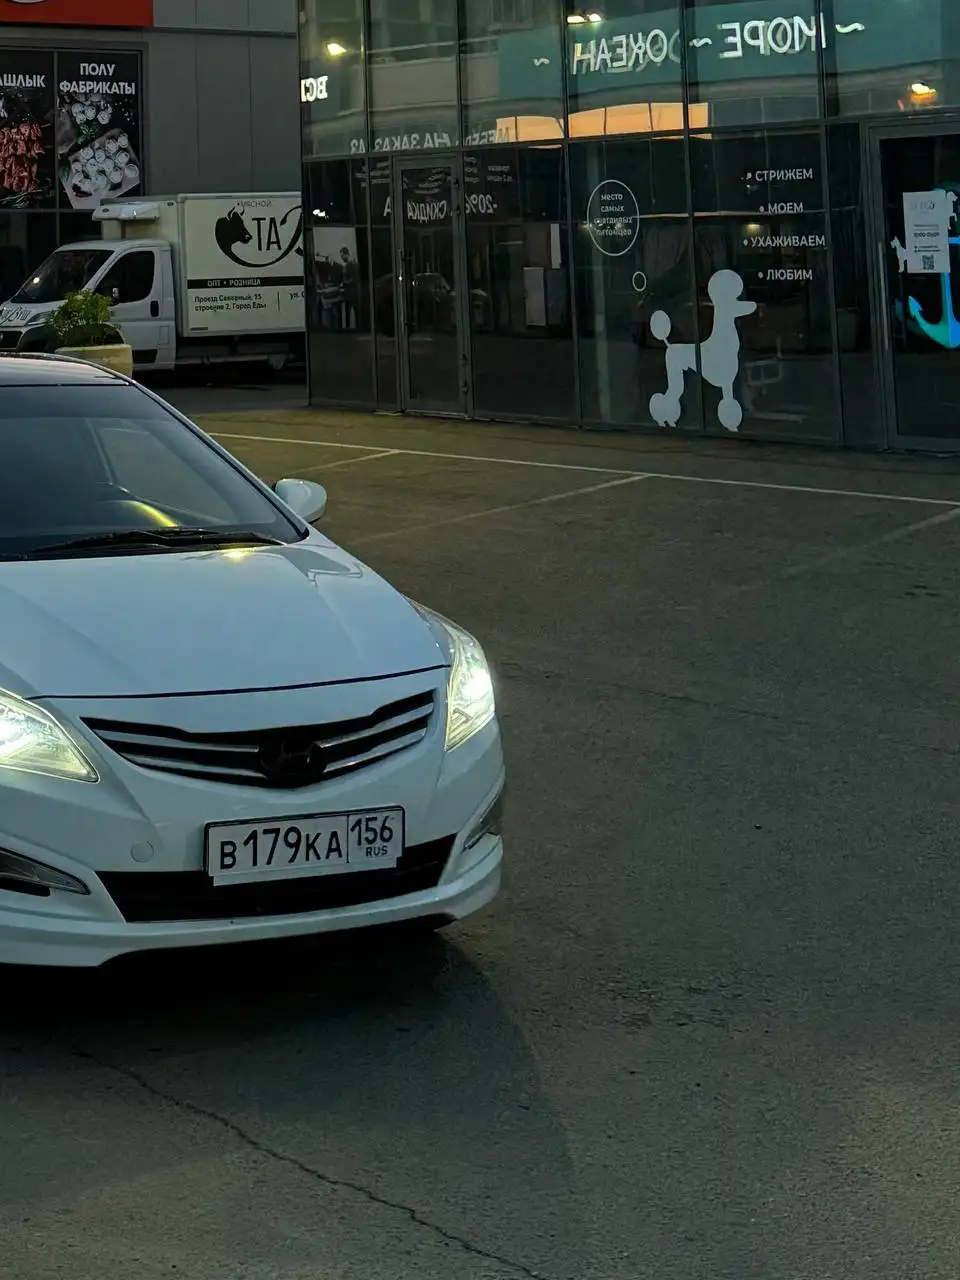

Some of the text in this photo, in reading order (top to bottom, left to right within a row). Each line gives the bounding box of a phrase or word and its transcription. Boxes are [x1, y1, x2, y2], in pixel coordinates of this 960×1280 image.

[79, 63, 115, 76] ПОЛУ
[59, 80, 136, 95] ФАБРИКАТЫ
[755, 168, 813, 182] СТРИЖЕМ
[768, 202, 804, 214] МОЕМ
[750, 235, 825, 248] УХАЖИВАЕМ
[767, 269, 813, 281] ЛЮБИМ
[229, 278, 261, 287] РОЗНИЦА
[232, 302, 251, 311] Город
[219, 816, 394, 870] В179КА 156
[365, 845, 389, 857] RUS
